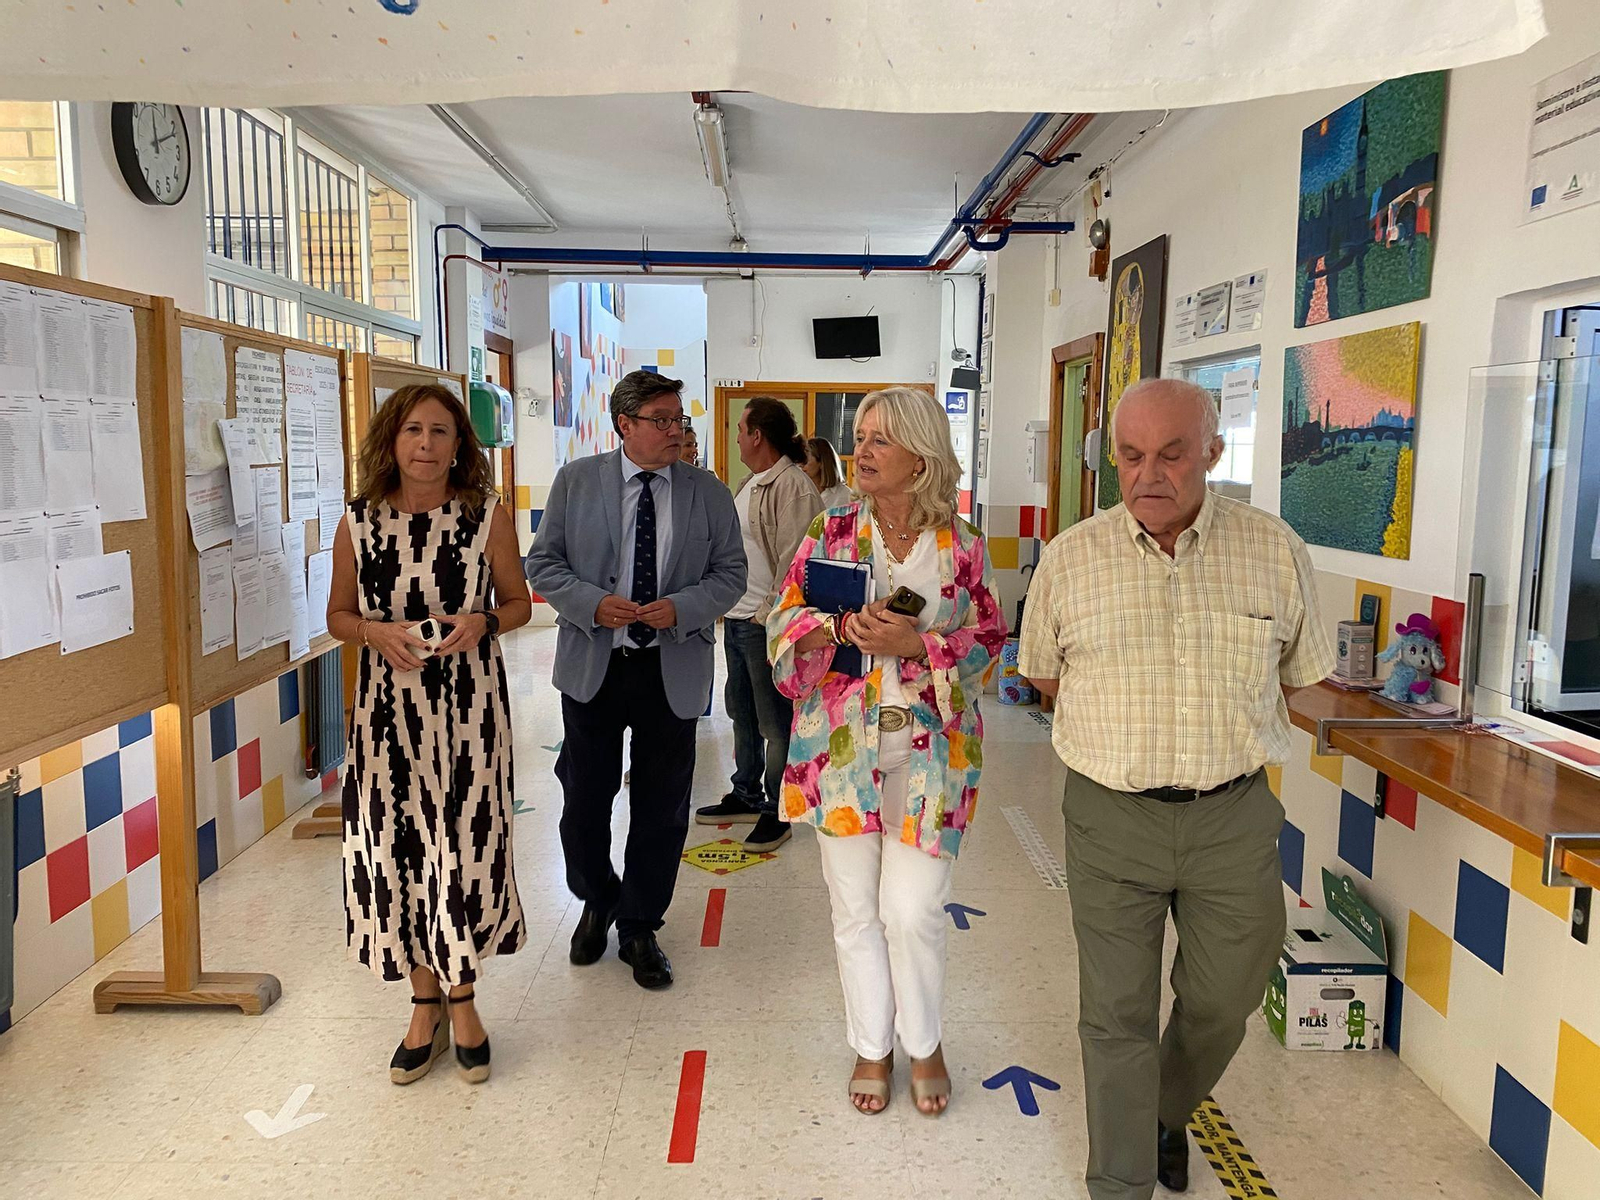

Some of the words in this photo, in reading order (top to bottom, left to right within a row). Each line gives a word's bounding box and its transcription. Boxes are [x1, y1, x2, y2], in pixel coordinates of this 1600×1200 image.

[1534, 103, 1564, 125] material
[306, 367, 313, 378] DE
[1213, 1142, 1258, 1198] MANTENGA
